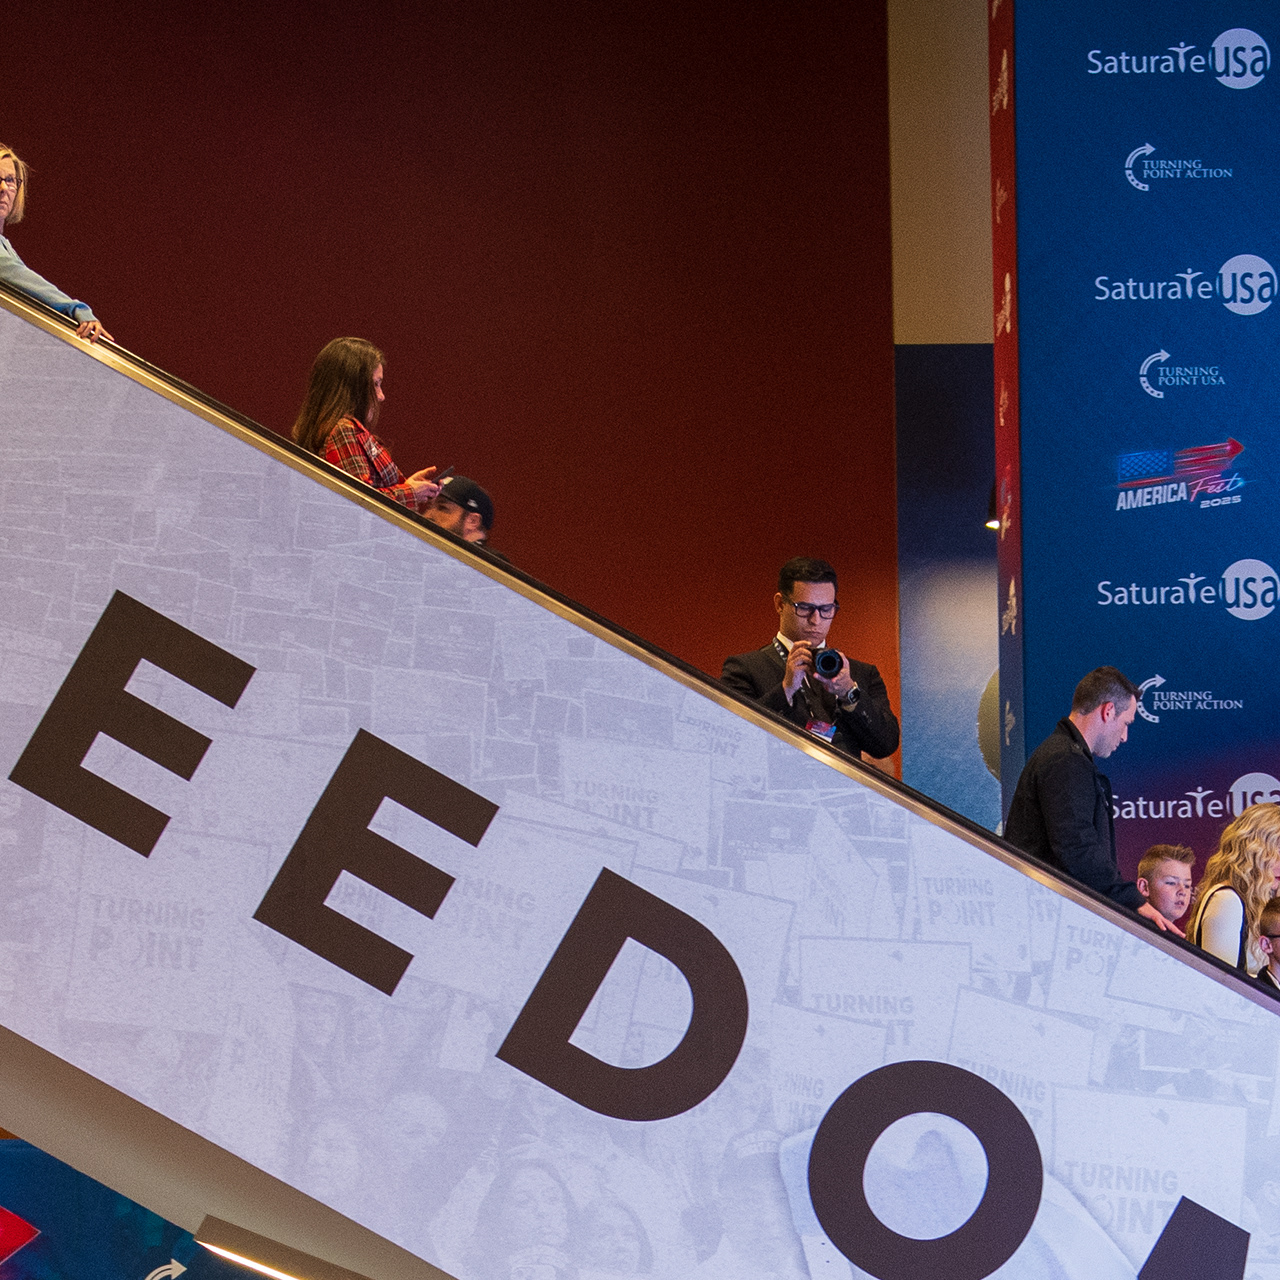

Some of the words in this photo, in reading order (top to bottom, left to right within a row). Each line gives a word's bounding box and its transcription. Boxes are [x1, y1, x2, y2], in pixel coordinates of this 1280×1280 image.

[1142, 159, 1202, 169] TURNING
[1142, 168, 1183, 178] POINT
[1185, 168, 1233, 178] ACTION
[1158, 366, 1219, 377] TURNING
[1158, 375, 1199, 386] POINT
[1201, 375, 1225, 386] USA
[1115, 481, 1188, 511] AMERICA
[1189, 473, 1241, 502] Fest
[1200, 494, 1242, 509] 2025
[1152, 691, 1212, 701] TURNING
[1152, 700, 1194, 710] POINT
[1196, 700, 1244, 710] ACTION
